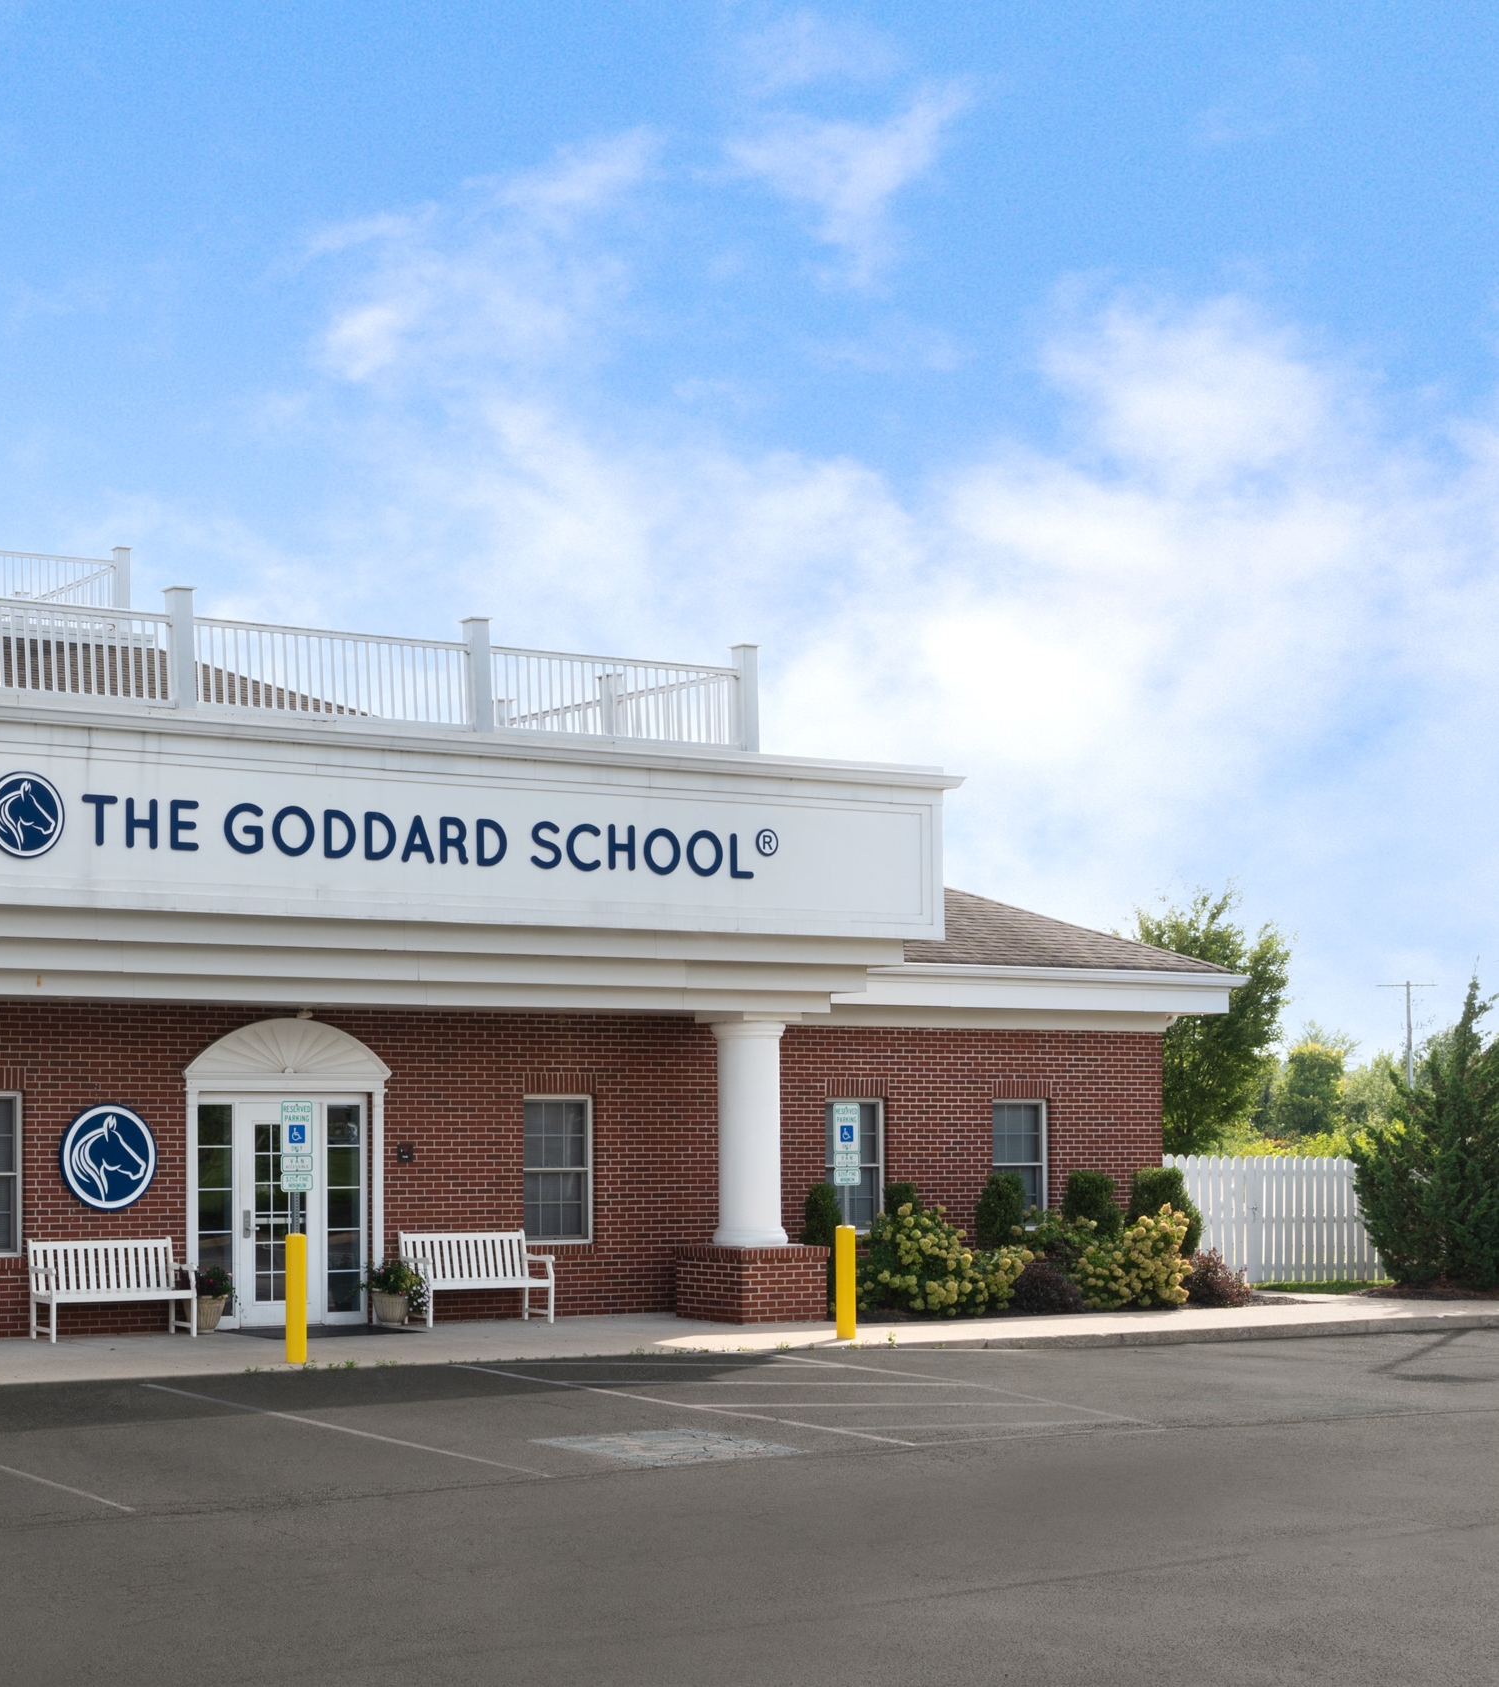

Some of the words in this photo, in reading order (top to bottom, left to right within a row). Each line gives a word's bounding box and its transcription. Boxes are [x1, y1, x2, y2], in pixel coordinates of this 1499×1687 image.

[81, 793, 199, 852] THE
[223, 802, 508, 868] GODDARD
[283, 1105, 311, 1113] RESERVED
